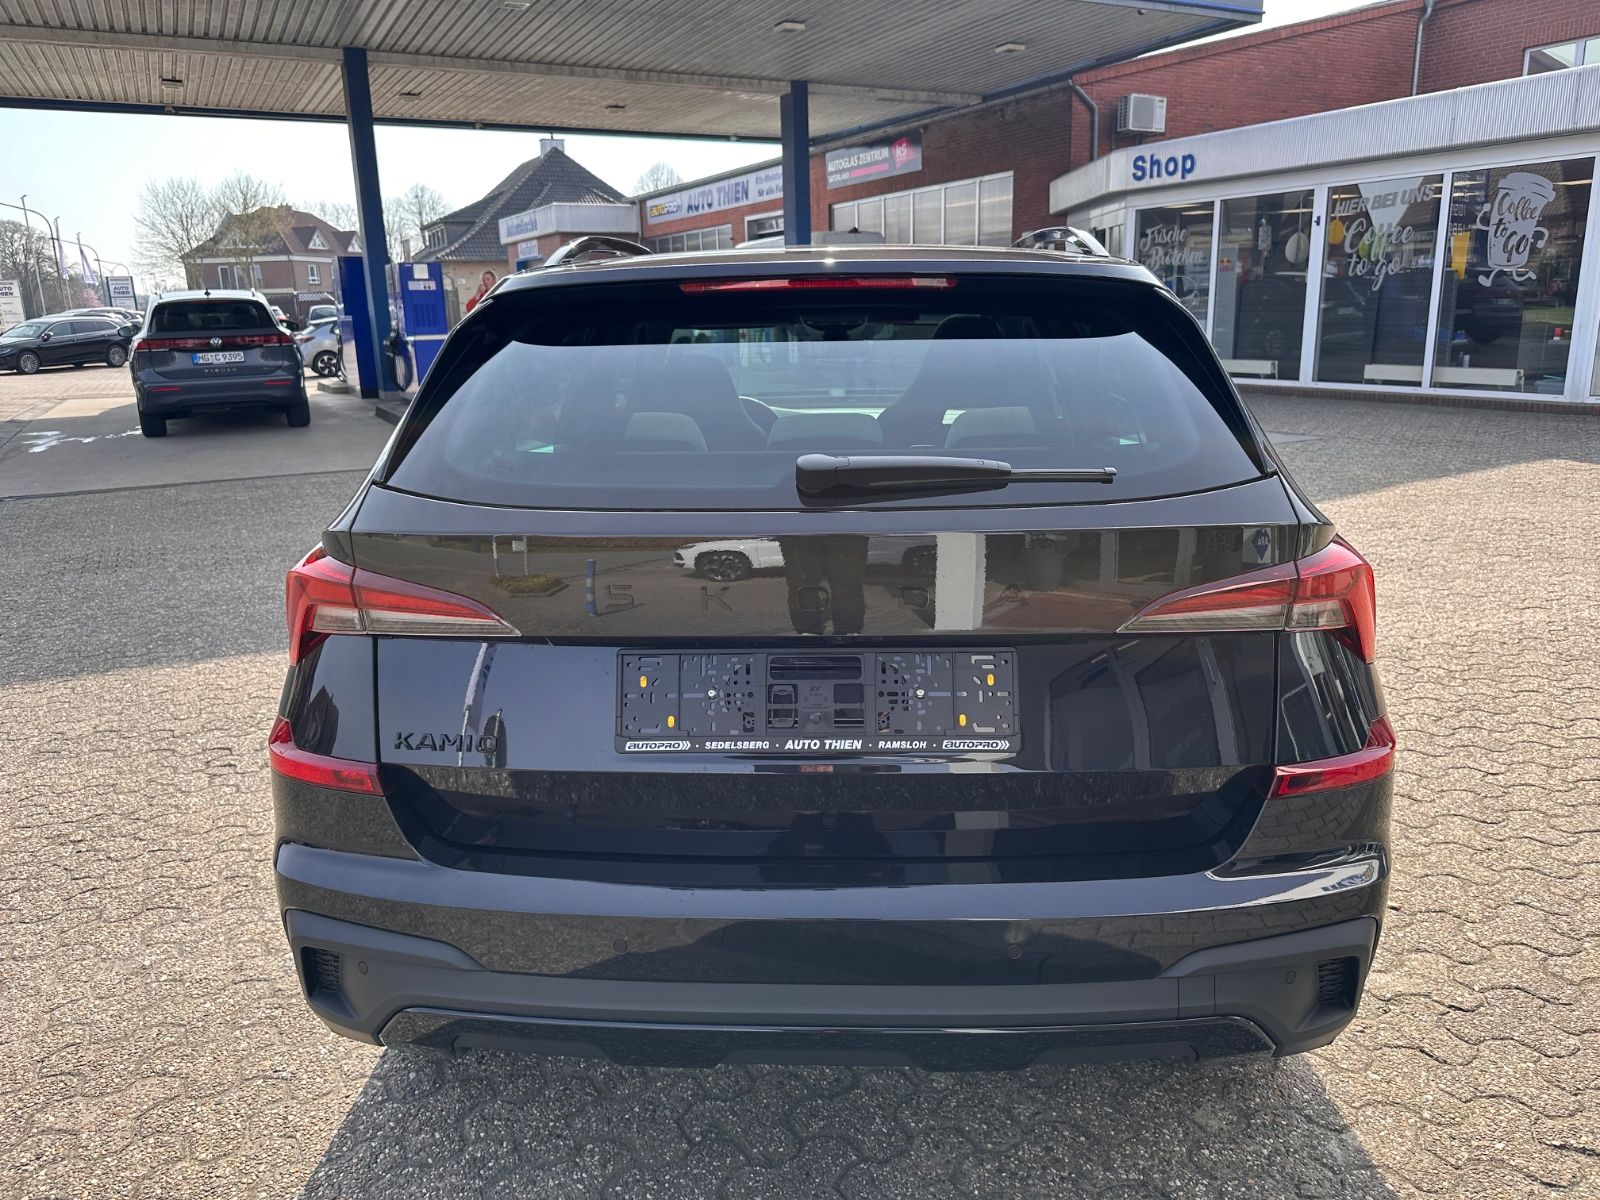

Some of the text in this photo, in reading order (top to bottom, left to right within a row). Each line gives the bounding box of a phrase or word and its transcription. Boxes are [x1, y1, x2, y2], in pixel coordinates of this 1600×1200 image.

[827, 147, 889, 171] AUTOGLAS ZENTRUM
[1132, 153, 1196, 181] Shop
[687, 188, 713, 214] AUTO
[717, 181, 749, 207] THIEN
[1334, 197, 1369, 215] HIER
[1371, 191, 1398, 210] BEI
[1400, 185, 1435, 205] UNS
[1497, 192, 1538, 221] Coffee
[1139, 224, 1187, 250] Frische
[1343, 217, 1413, 261] Coffee
[1492, 217, 1509, 238] to
[1347, 253, 1401, 292] to go
[222, 352, 243, 361] 9395
[394, 732, 498, 753] KAMIQ
[705, 741, 770, 749] SEDELSBERG
[784, 739, 820, 750] AUTO
[824, 739, 863, 750] THIEN
[878, 740, 927, 749] RAMSLOH
